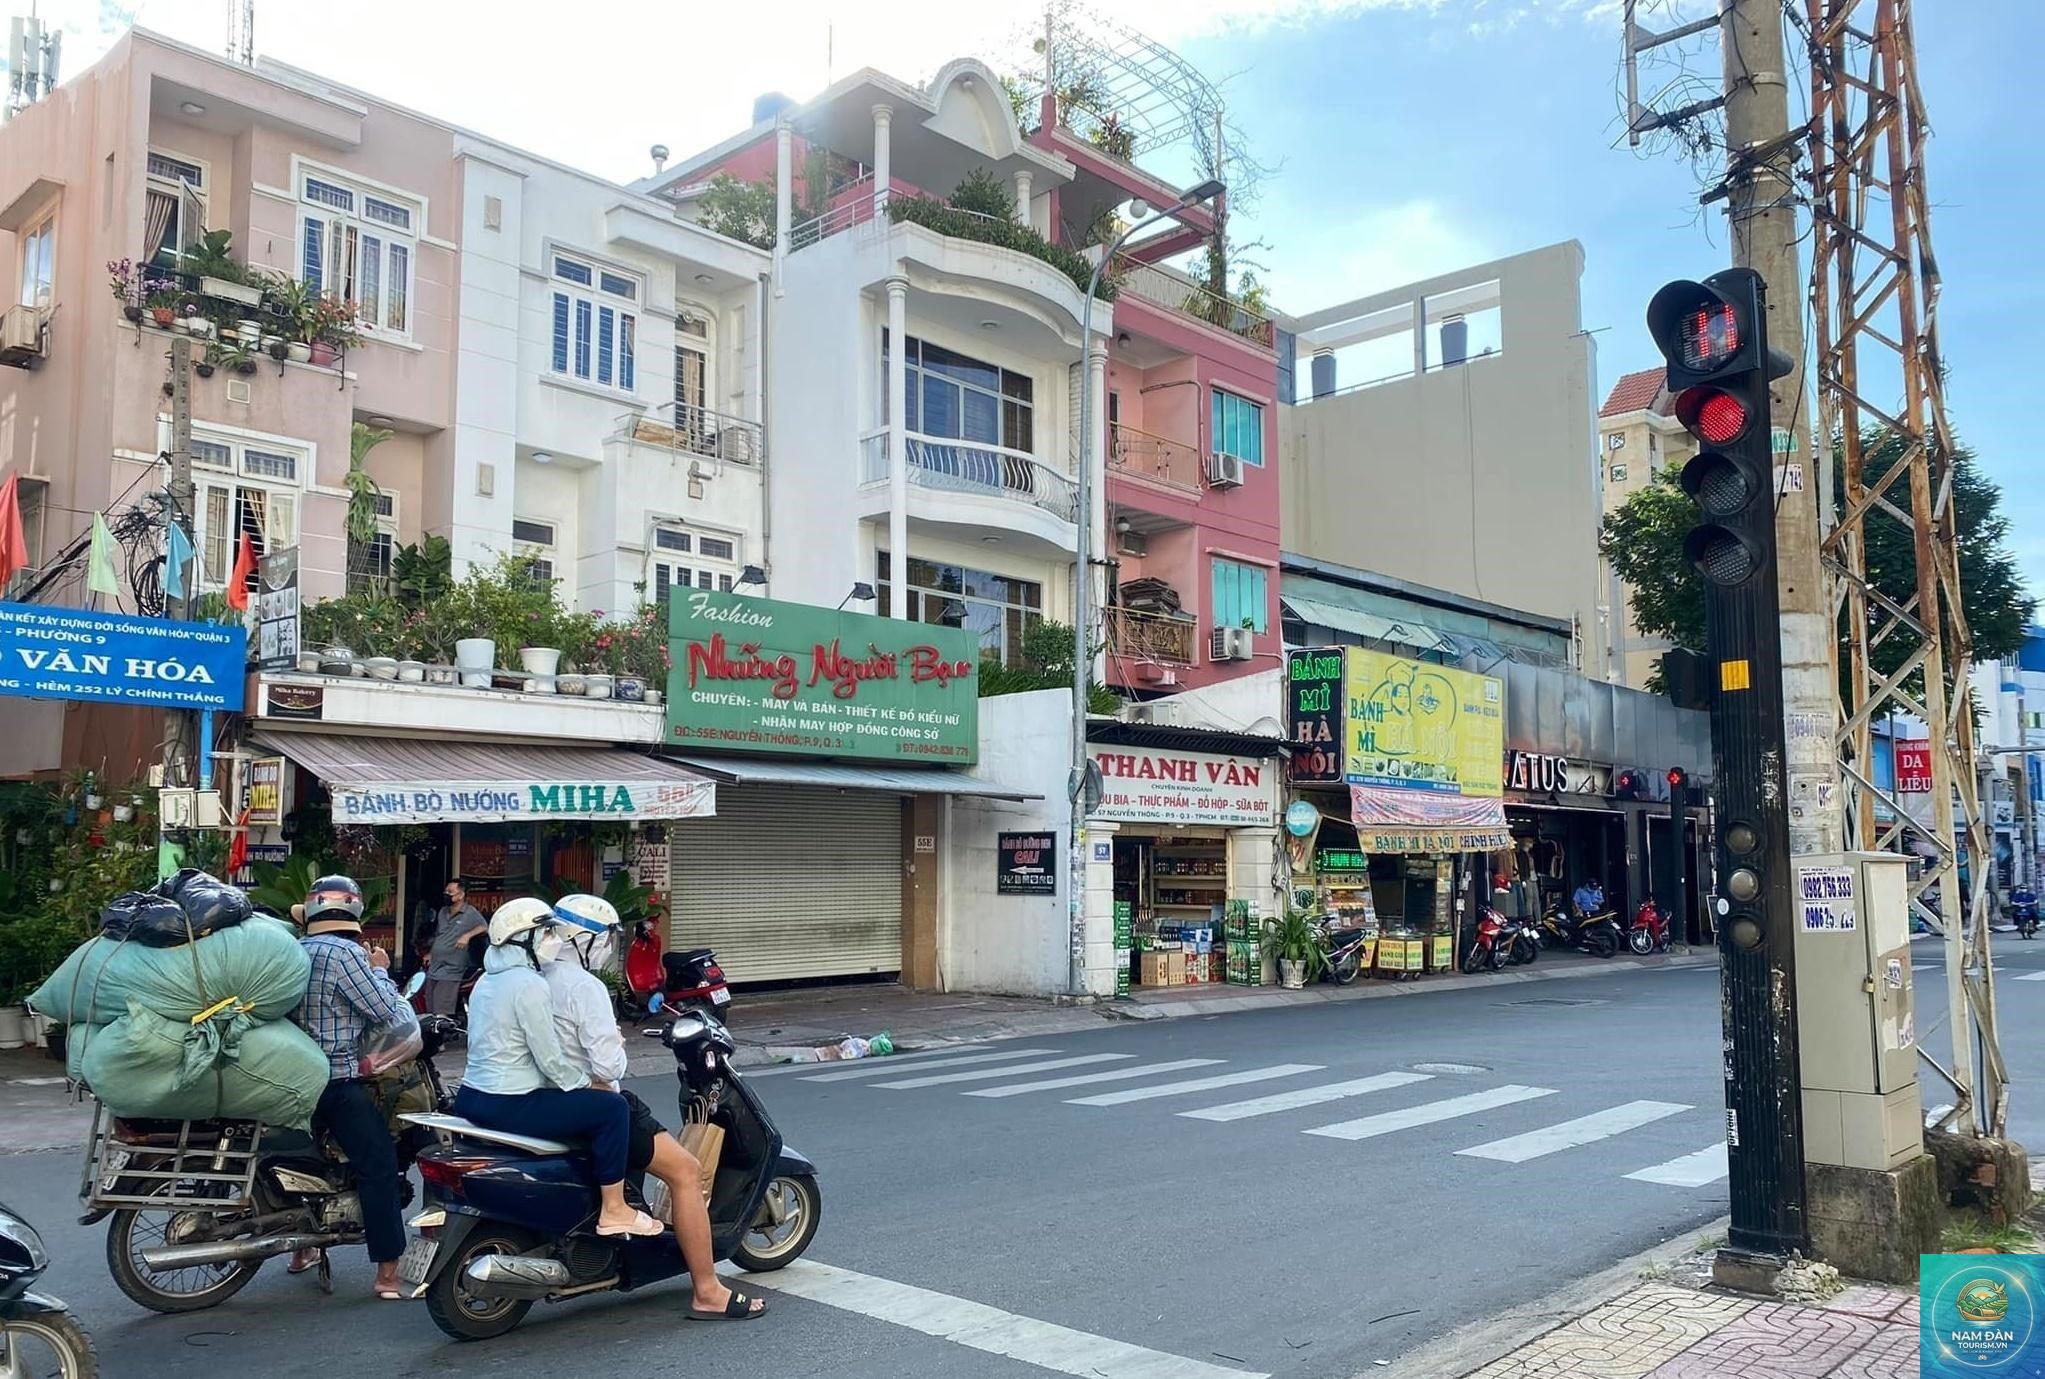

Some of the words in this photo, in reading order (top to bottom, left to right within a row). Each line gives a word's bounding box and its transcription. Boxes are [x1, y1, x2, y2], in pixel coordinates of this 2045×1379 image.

[688, 592, 773, 628] Fashion
[15, 612, 37, 624] KẾT
[38, 615, 59, 626] XÂY
[60, 618, 93, 630] DỰNG
[94, 621, 114, 632] ĐỜI
[115, 622, 145, 635] SỐNG
[145, 626, 167, 637] VĂN
[195, 632, 223, 645] QUẬN
[224, 635, 231, 644] 3
[15, 627, 93, 644] PHƯỜNG
[95, 635, 107, 645] 9
[15, 647, 112, 676] VĂN
[124, 656, 215, 684] HÓA
[687, 632, 799, 700] Những
[806, 638, 899, 700] Người
[902, 645, 973, 688] Bạn
[1291, 651, 1341, 681] BÁNH
[73, 684, 103, 695] 252
[125, 688, 173, 700] CHÍNH
[691, 691, 751, 707] CHUYÊN:
[762, 698, 793, 711] MAY
[793, 700, 808, 713] VÀ
[812, 701, 837, 715] BÁN
[844, 703, 878, 719] THIẾT
[881, 707, 897, 720] KẾ
[899, 709, 915, 722] ĐỒ
[918, 709, 943, 724] KIỂU
[944, 714, 961, 727] NỮ
[1350, 693, 1384, 723] BÁNH
[761, 715, 796, 731] NHẬN
[799, 719, 826, 731] MAY
[829, 721, 854, 736] HỢP
[857, 721, 889, 738] ĐỒNG
[890, 724, 922, 739] CÔNG
[923, 727, 940, 741] SỞ
[1297, 714, 1333, 742] HÀ
[1357, 725, 1376, 753] MÌ
[1096, 752, 1198, 783] THANH
[1205, 757, 1261, 788] VÂN
[1294, 746, 1336, 779] NỘI
[1503, 751, 1569, 793] ATUS
[1902, 754, 1924, 769] DA
[414, 789, 443, 812] BÒ
[451, 788, 520, 812] NƯỚNG
[528, 784, 636, 814] MIHA
[1113, 794, 1129, 806] BIA
[1138, 794, 1162, 809] THỰC
[1163, 792, 1190, 808] PHẨM
[1197, 794, 1210, 809] ĐỒ
[1211, 797, 1229, 811] HỘP
[1235, 798, 1252, 811] SỮA
[1253, 799, 1269, 813] BỘT
[1014, 851, 1040, 864] CALI
